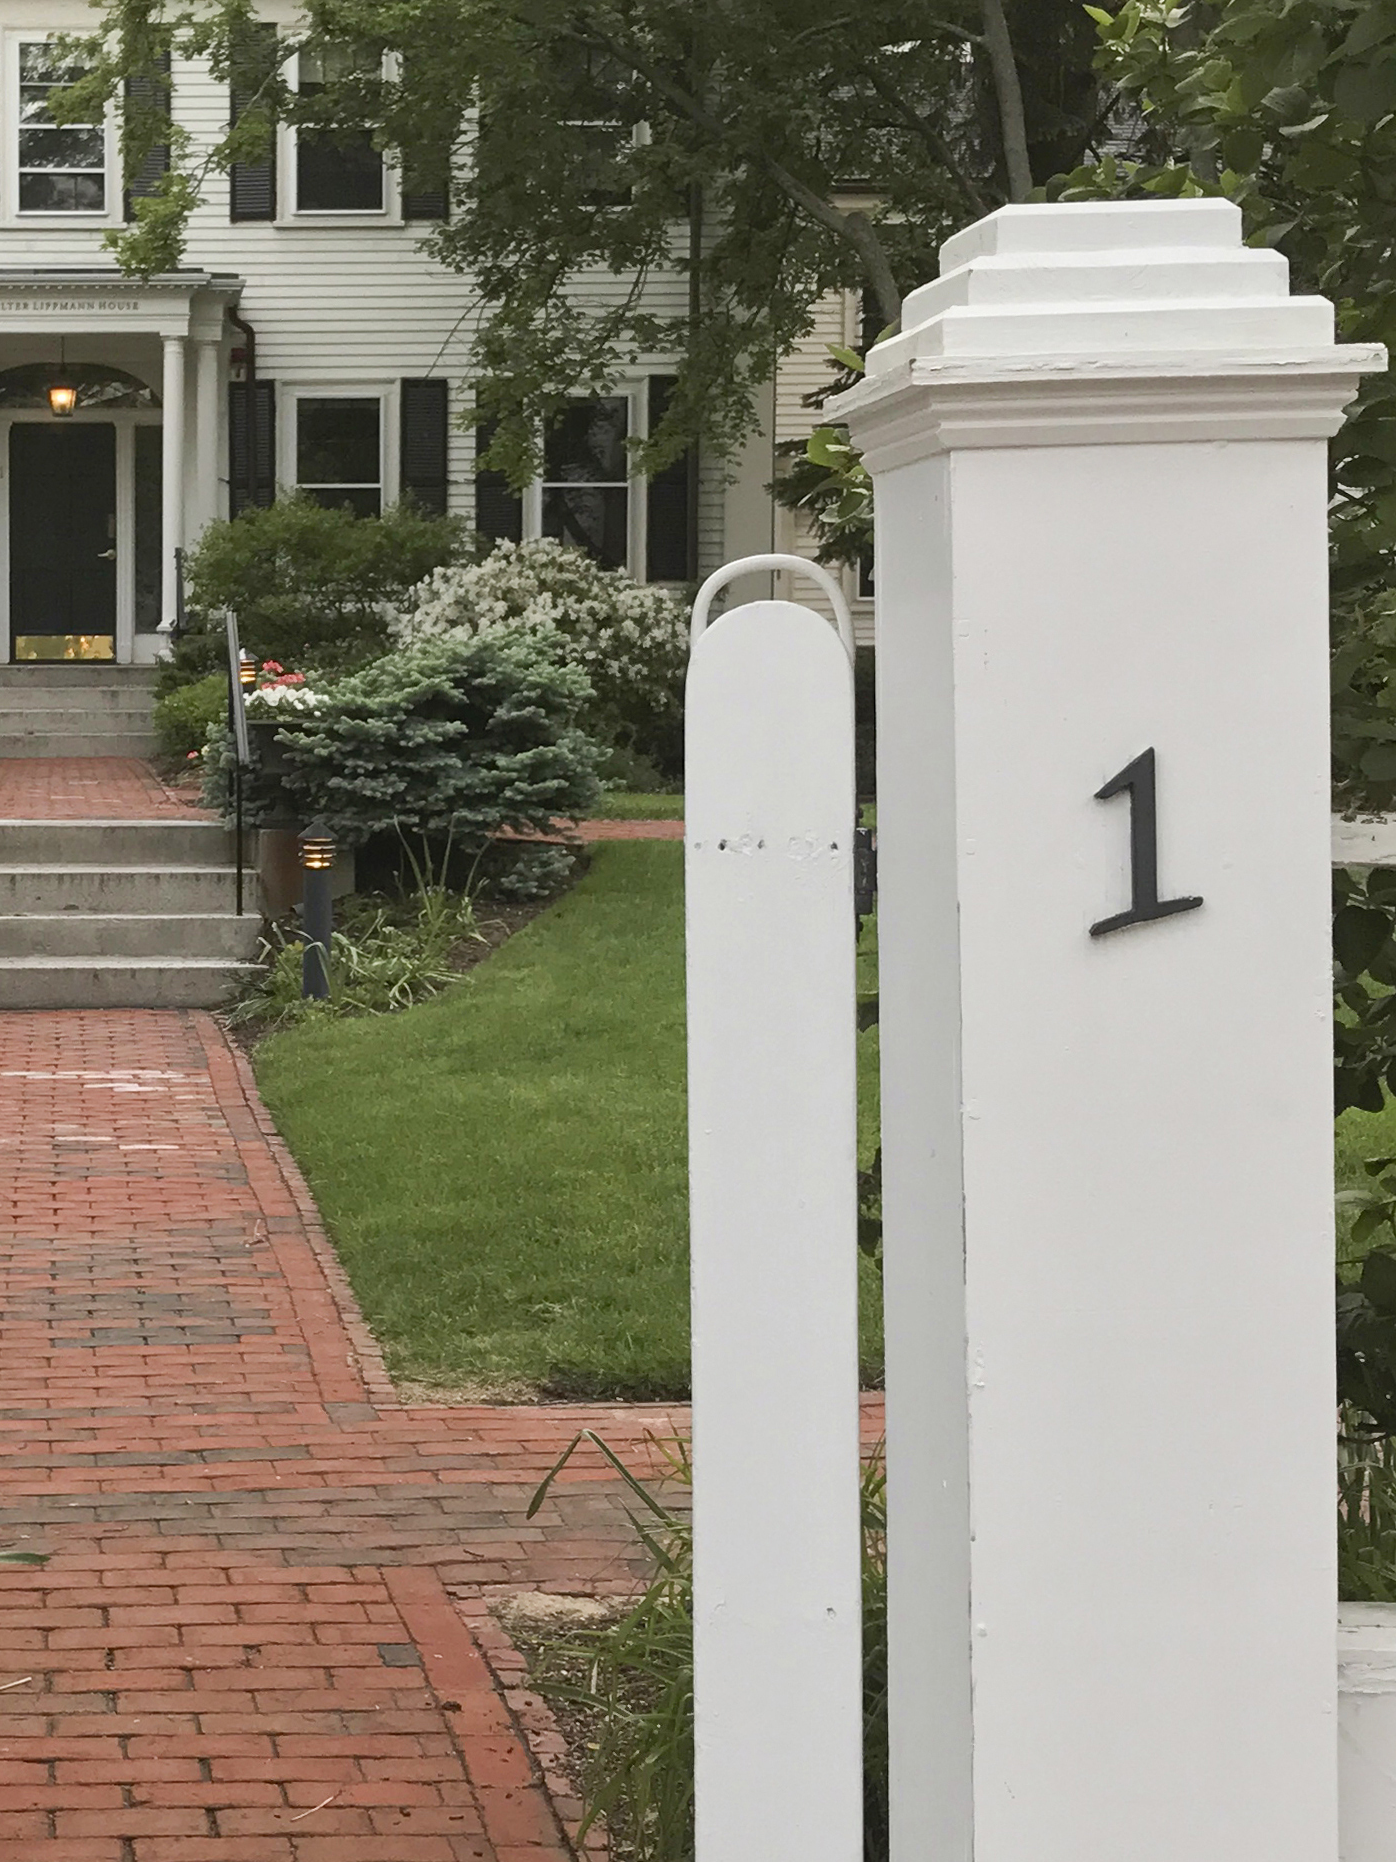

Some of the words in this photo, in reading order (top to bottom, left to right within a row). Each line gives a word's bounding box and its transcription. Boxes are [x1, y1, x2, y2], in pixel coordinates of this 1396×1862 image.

[32, 301, 95, 311] LIPPMANN
[98, 301, 140, 311] HOUSE
[1088, 746, 1204, 936] 1
